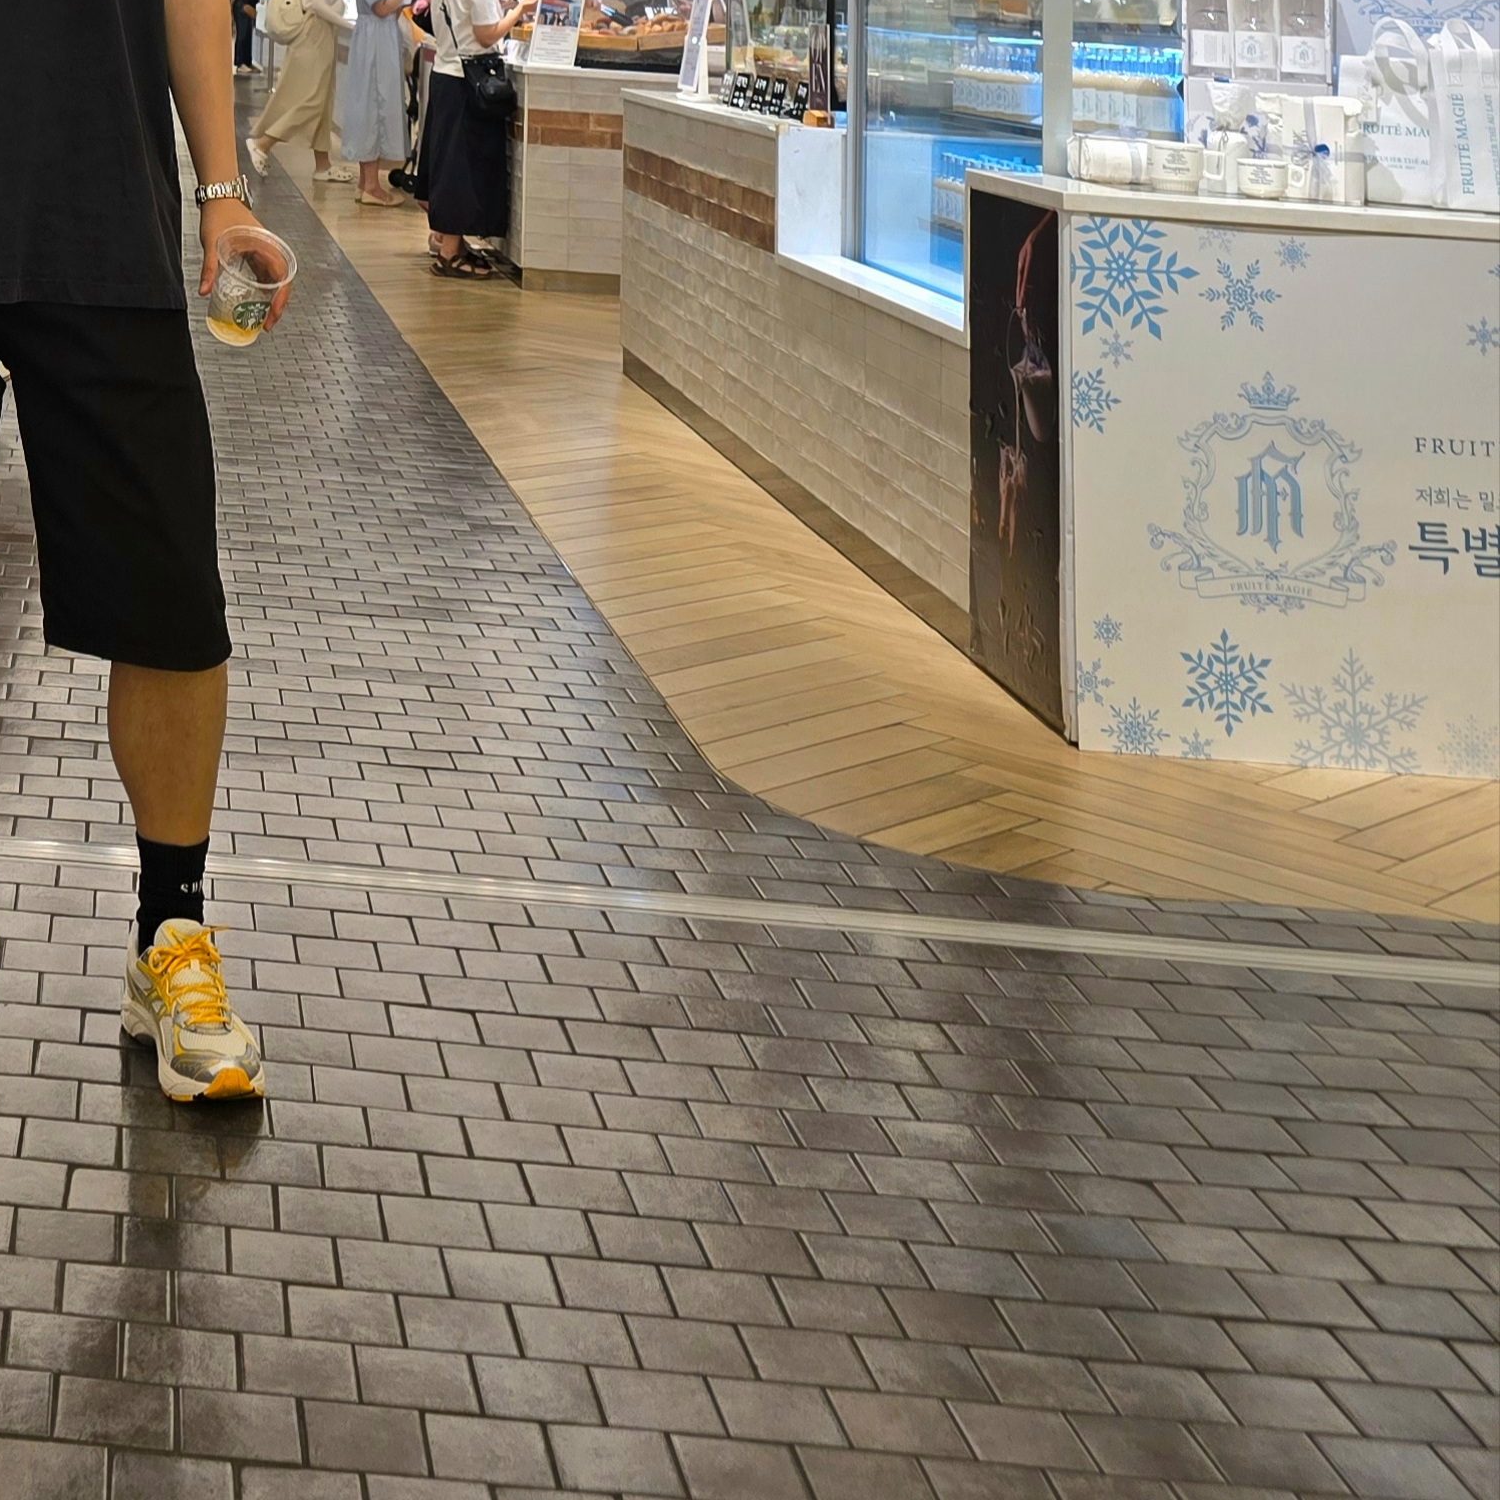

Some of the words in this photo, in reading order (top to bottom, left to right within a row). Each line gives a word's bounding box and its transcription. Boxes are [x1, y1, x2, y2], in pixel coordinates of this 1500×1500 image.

[1405, 126, 1430, 138] MA
[1416, 486, 1472, 510] 저희는
[1479, 491, 1500, 512] 밀
